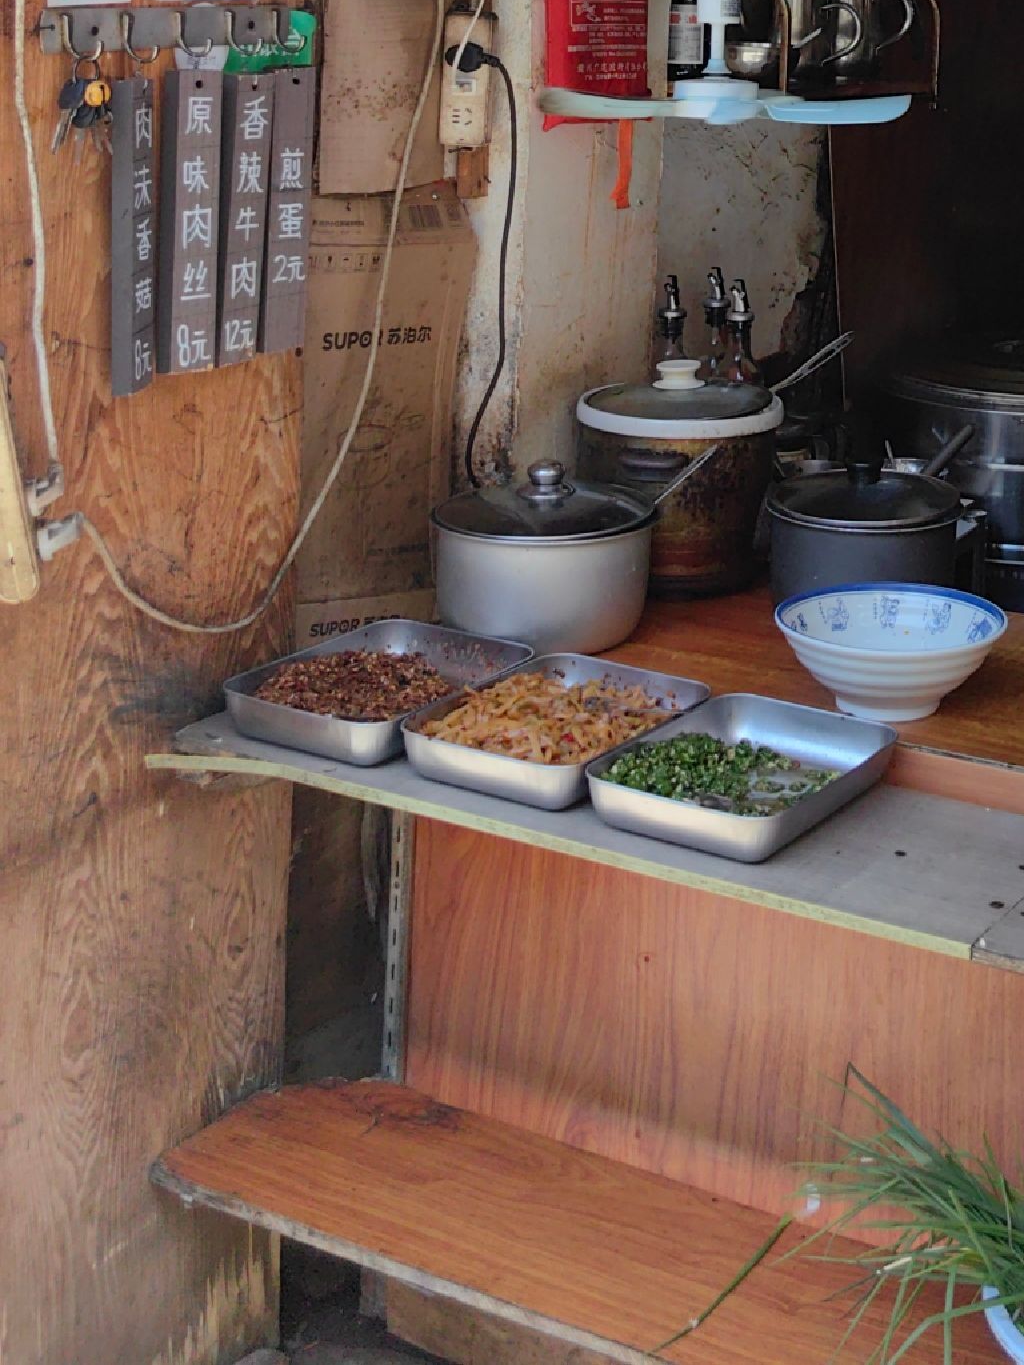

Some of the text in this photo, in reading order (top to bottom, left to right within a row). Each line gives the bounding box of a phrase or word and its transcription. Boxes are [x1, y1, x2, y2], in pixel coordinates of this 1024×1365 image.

[180, 96, 213, 302] 原味肉丝
[230, 94, 269, 300] 香辣牛肉
[277, 147, 306, 241] 煎蛋
[272, 254, 306, 284] 2元
[176, 323, 212, 368] 8元
[224, 319, 255, 353] 12元
[387, 325, 432, 345] 苏泊尔
[309, 618, 361, 638] SUPOR
